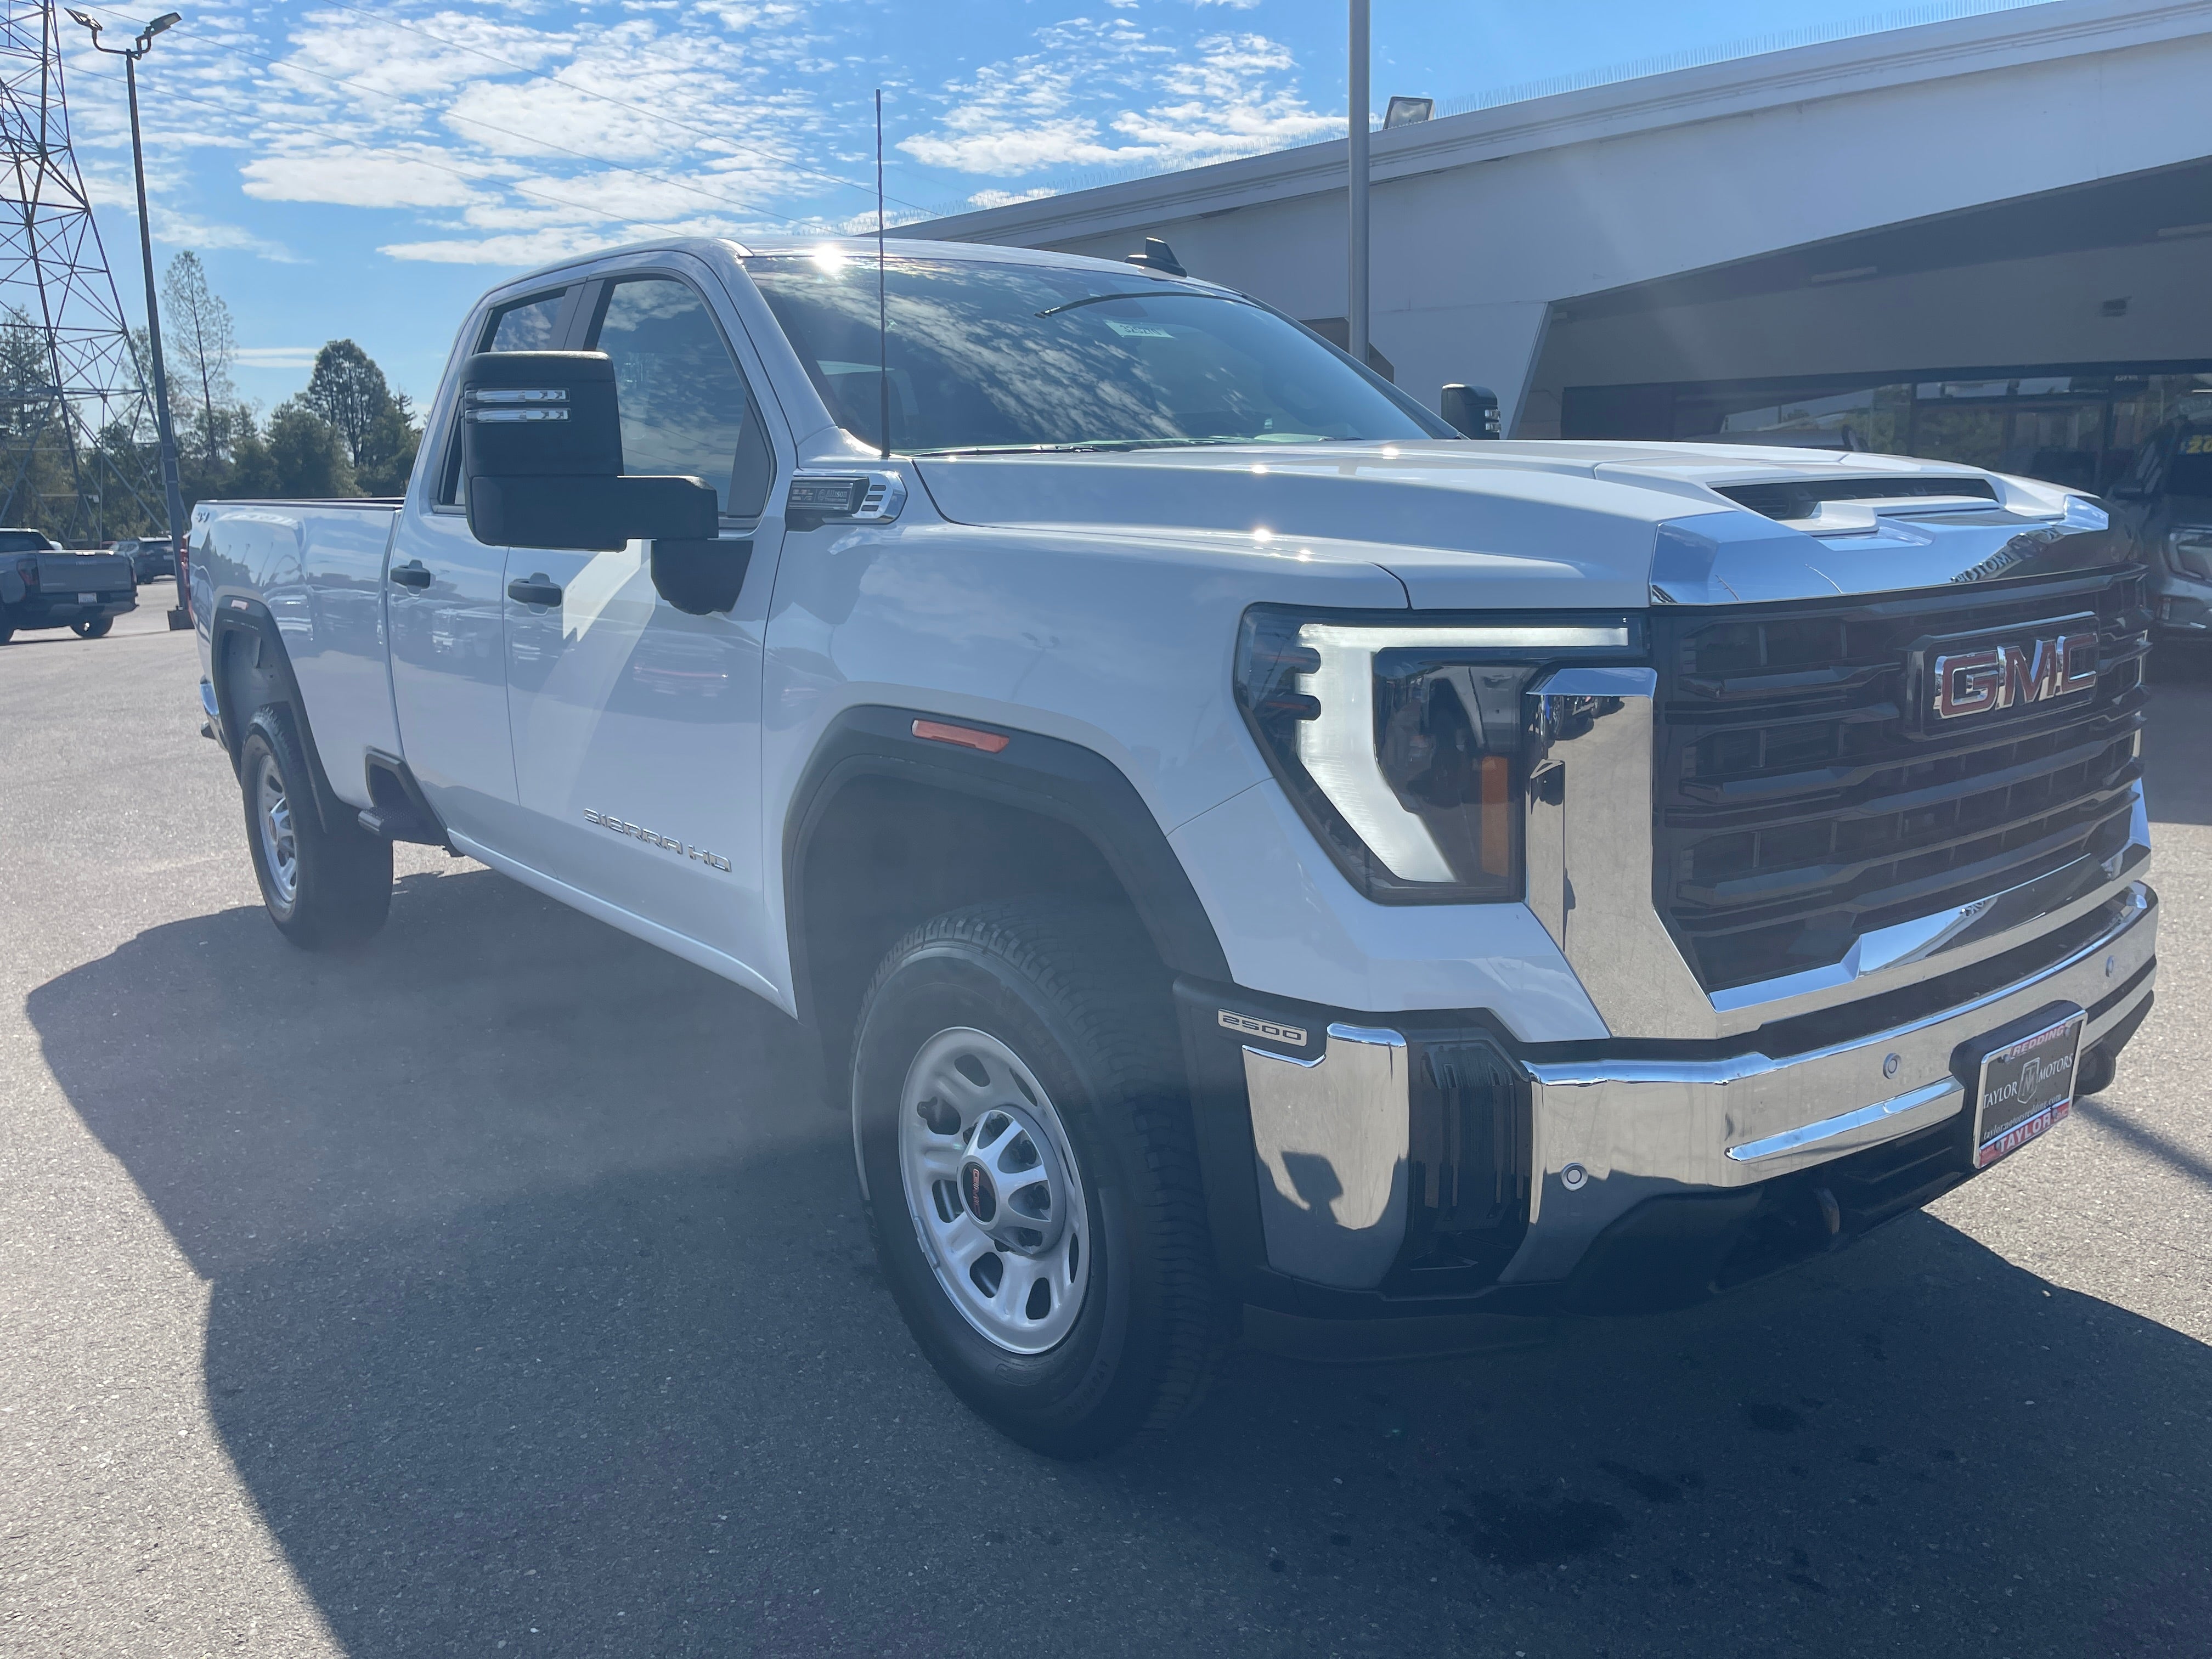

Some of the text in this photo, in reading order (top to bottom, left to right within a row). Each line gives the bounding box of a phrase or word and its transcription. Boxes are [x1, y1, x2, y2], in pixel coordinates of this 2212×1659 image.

[1934, 632, 2099, 719] GMC
[583, 808, 732, 872] SIERRA HD
[1222, 1014, 1302, 1041] 2500
[2012, 1025, 2065, 1057] REDDING
[1983, 1053, 2073, 1109] TAYLOR MOTORS
[1999, 1112, 2051, 1153] TAYLOR
